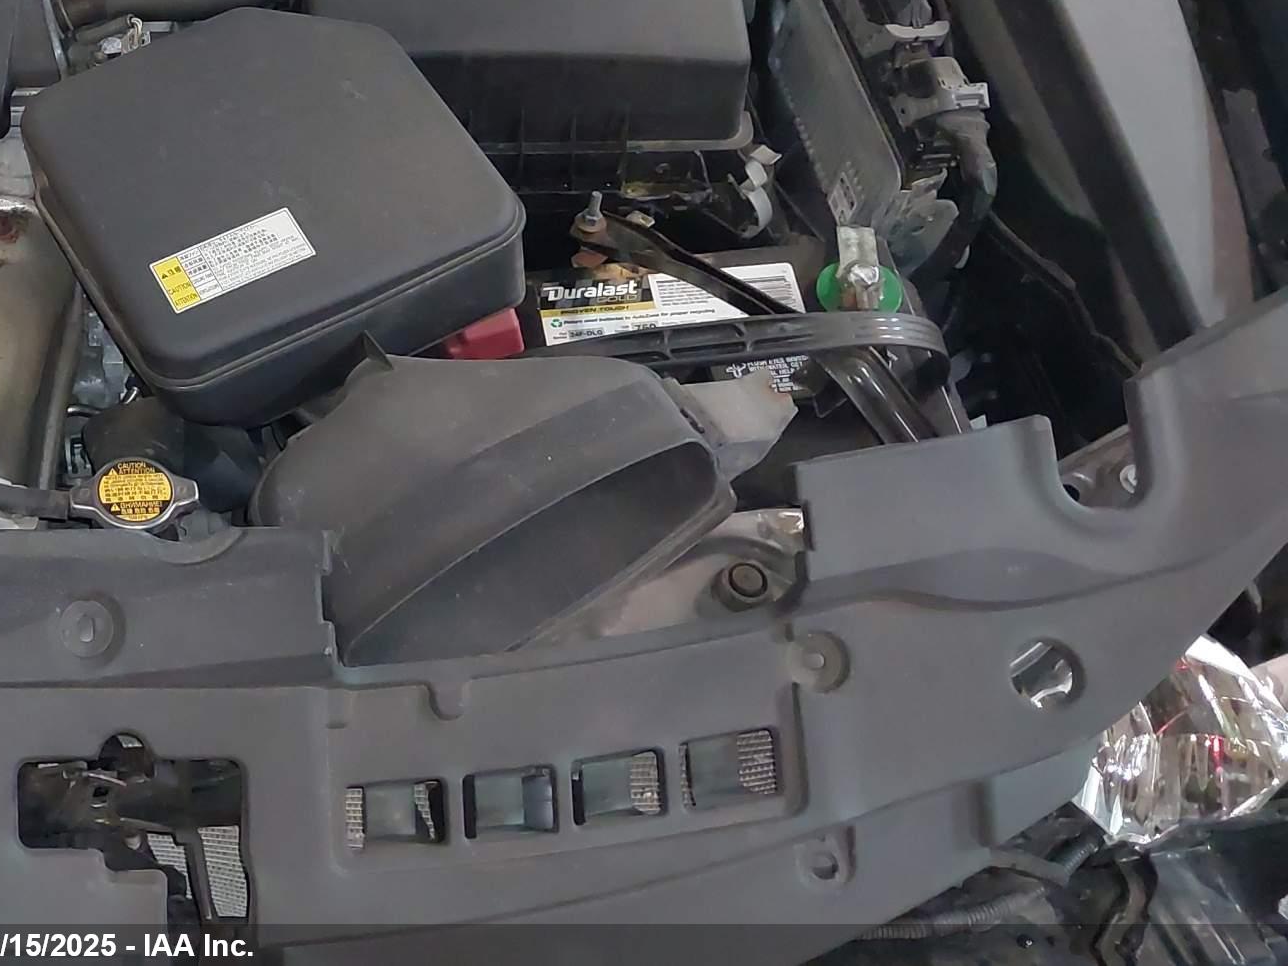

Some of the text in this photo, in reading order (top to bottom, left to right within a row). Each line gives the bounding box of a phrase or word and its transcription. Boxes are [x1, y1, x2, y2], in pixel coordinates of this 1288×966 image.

[168, 282, 192, 296] CAUTION
[543, 280, 638, 301] Duralast
[174, 293, 198, 306] ATTENTION
[596, 294, 638, 303] GOLD
[118, 467, 156, 475] ATTENTION
